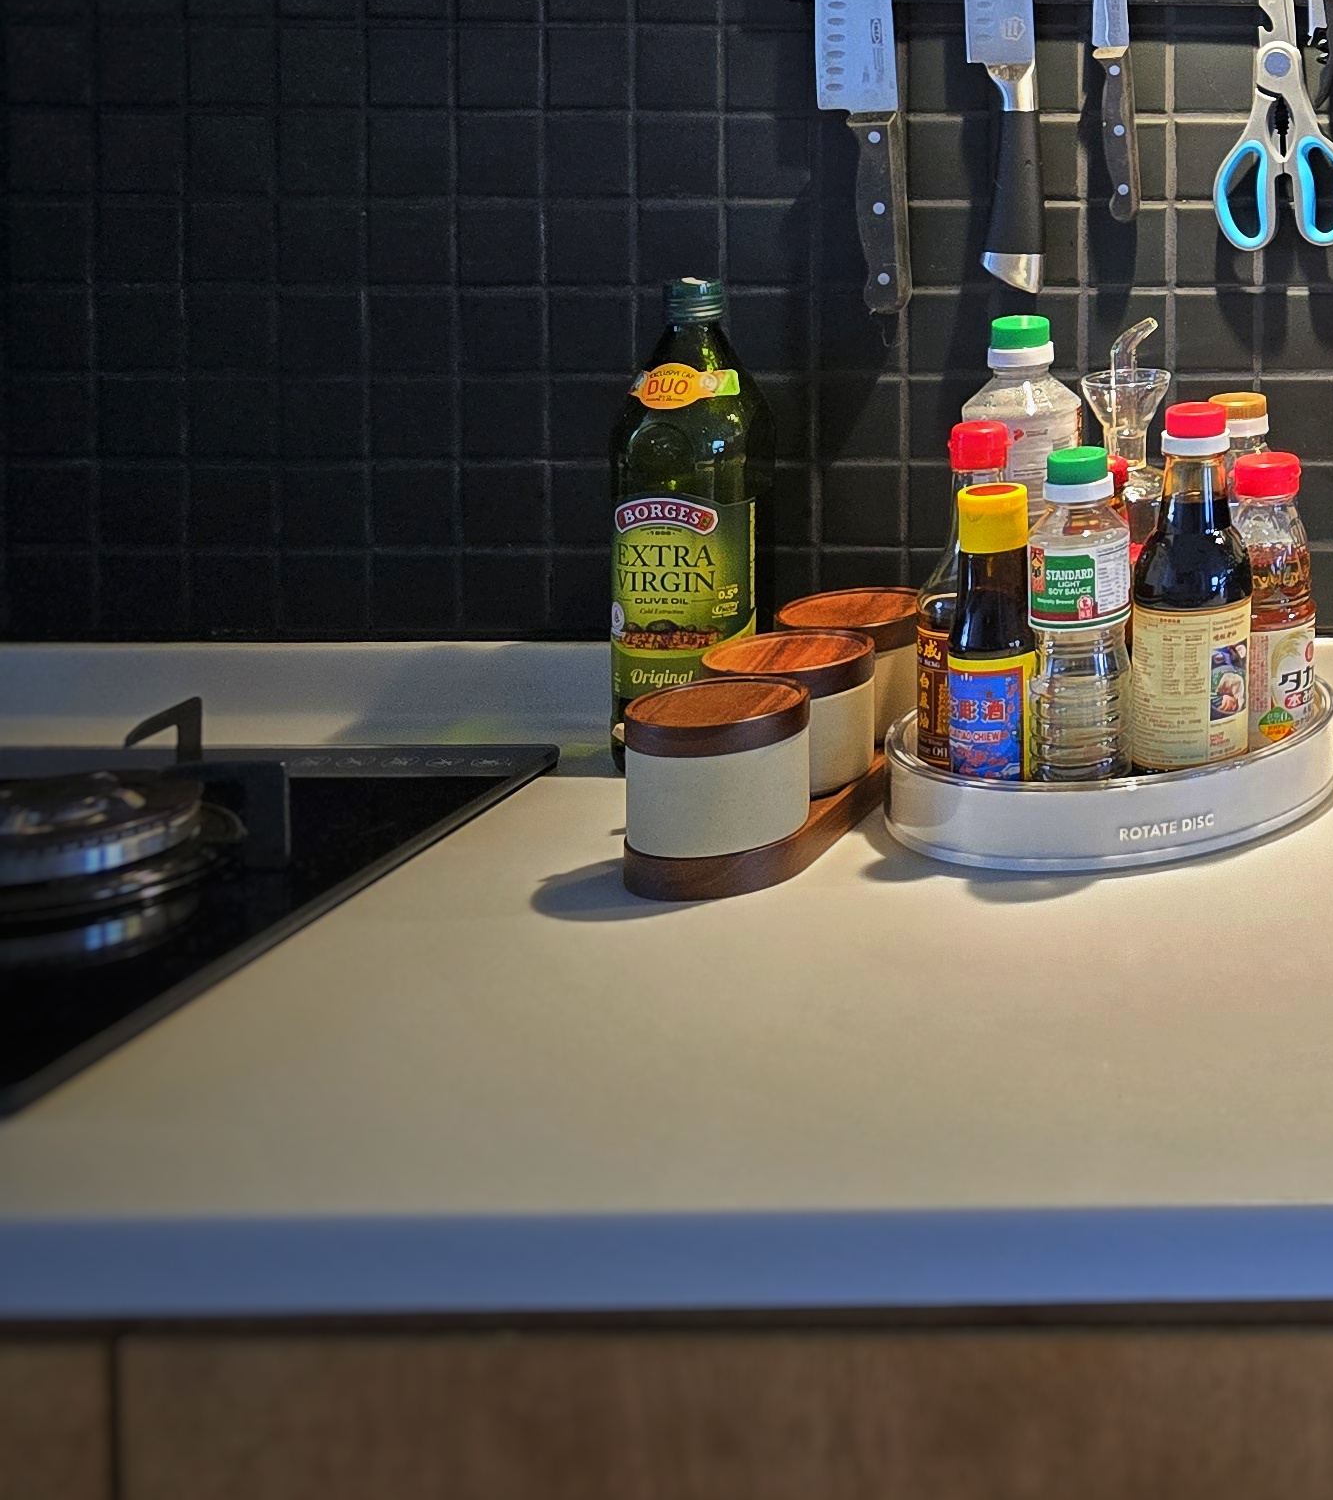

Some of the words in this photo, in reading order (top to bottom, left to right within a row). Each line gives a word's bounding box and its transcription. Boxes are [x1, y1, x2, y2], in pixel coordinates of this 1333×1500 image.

[647, 377, 689, 396] DUO
[623, 503, 702, 526] BORGES
[617, 543, 716, 568] EXTRA
[617, 569, 716, 593] VIRGIN
[1045, 567, 1094, 581] STANDARD
[1047, 587, 1064, 596] SOY
[1064, 586, 1092, 596] SAUCE
[1057, 580, 1081, 588] LIGHT
[634, 597, 669, 605] OLIVE
[670, 597, 689, 605] OIL
[630, 669, 694, 688] Original
[932, 746, 948, 758] Oil
[1119, 820, 1178, 841] ROTATE
[1181, 813, 1215, 832] DISC
